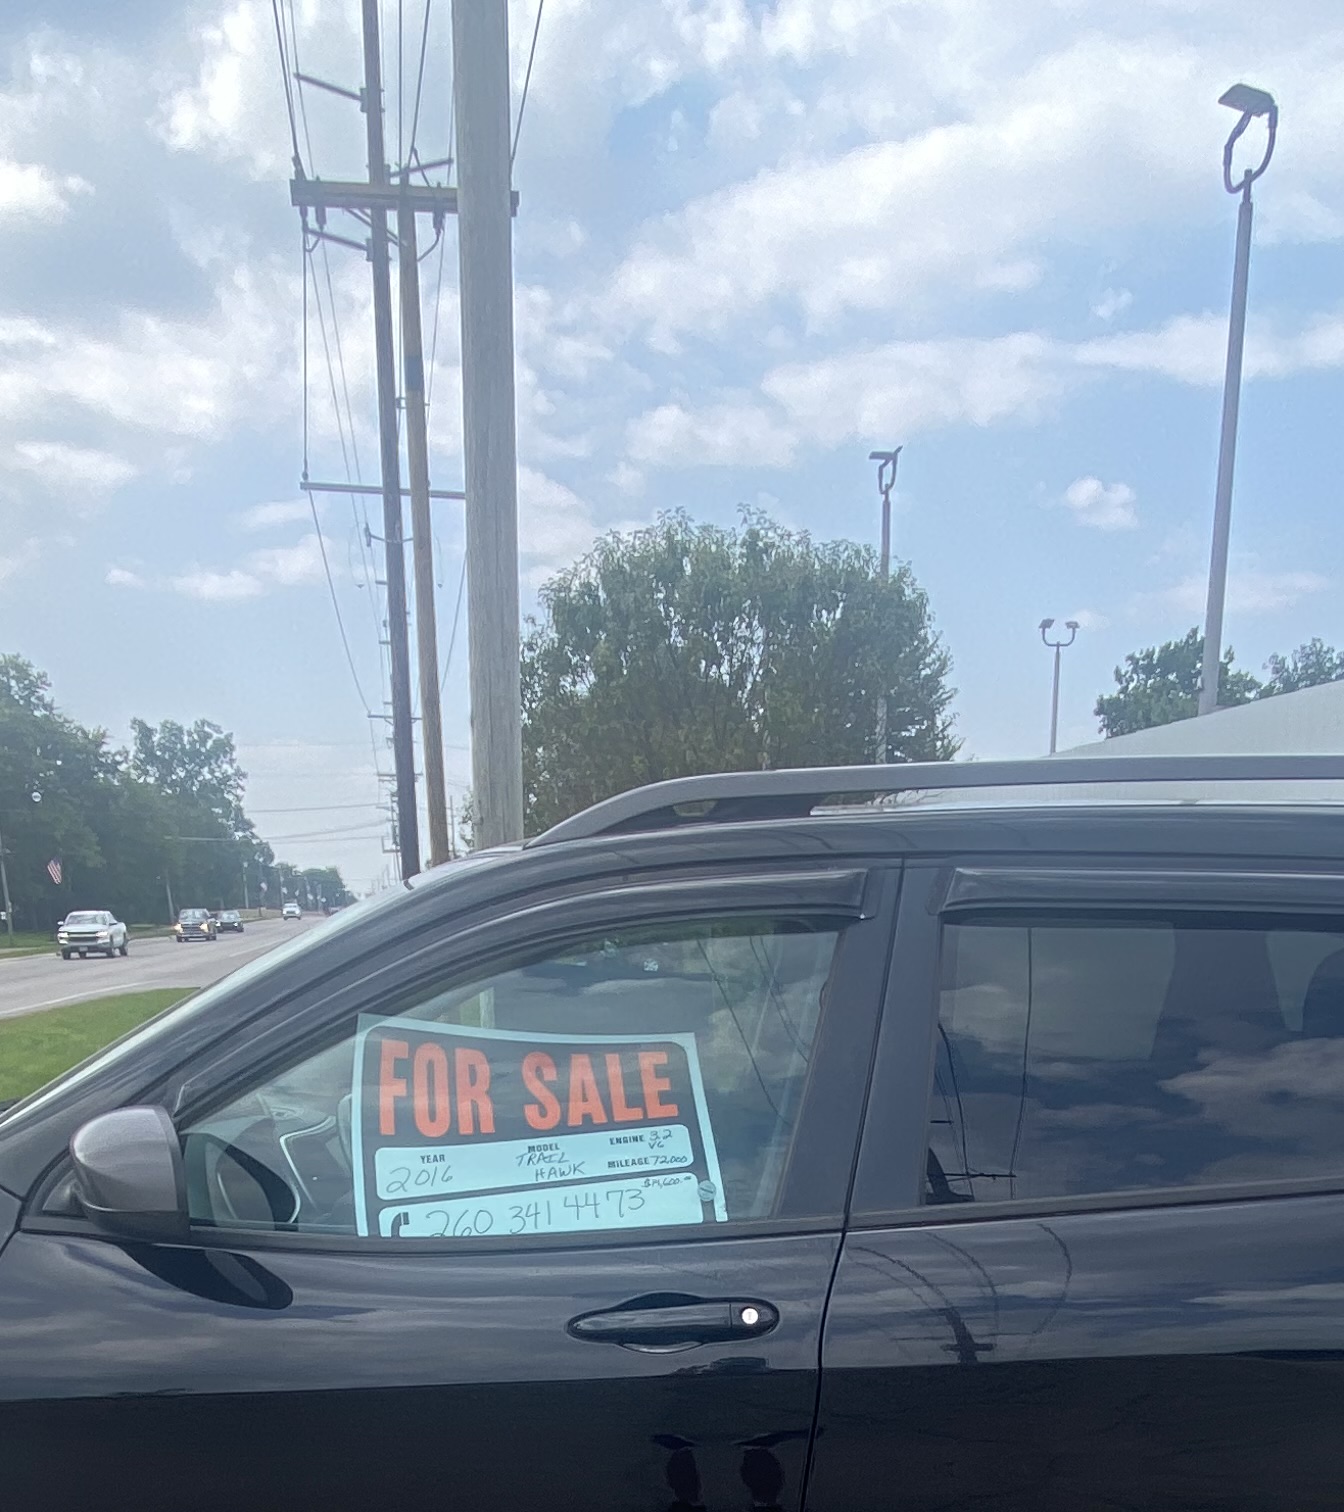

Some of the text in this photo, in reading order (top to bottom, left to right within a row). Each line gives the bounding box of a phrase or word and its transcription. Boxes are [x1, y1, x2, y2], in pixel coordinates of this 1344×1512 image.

[379, 1038, 679, 1138] FOR SALE
[527, 1142, 561, 1154] MODEL
[608, 1134, 645, 1146] ENGINE
[648, 1140, 666, 1150] V6
[420, 1154, 446, 1165] YEAR
[515, 1151, 570, 1167] TRAIL
[535, 1160, 586, 1182] HAWK
[386, 1165, 454, 1194] 2016
[426, 1208, 494, 1237] 260
[509, 1200, 551, 1235] 341
